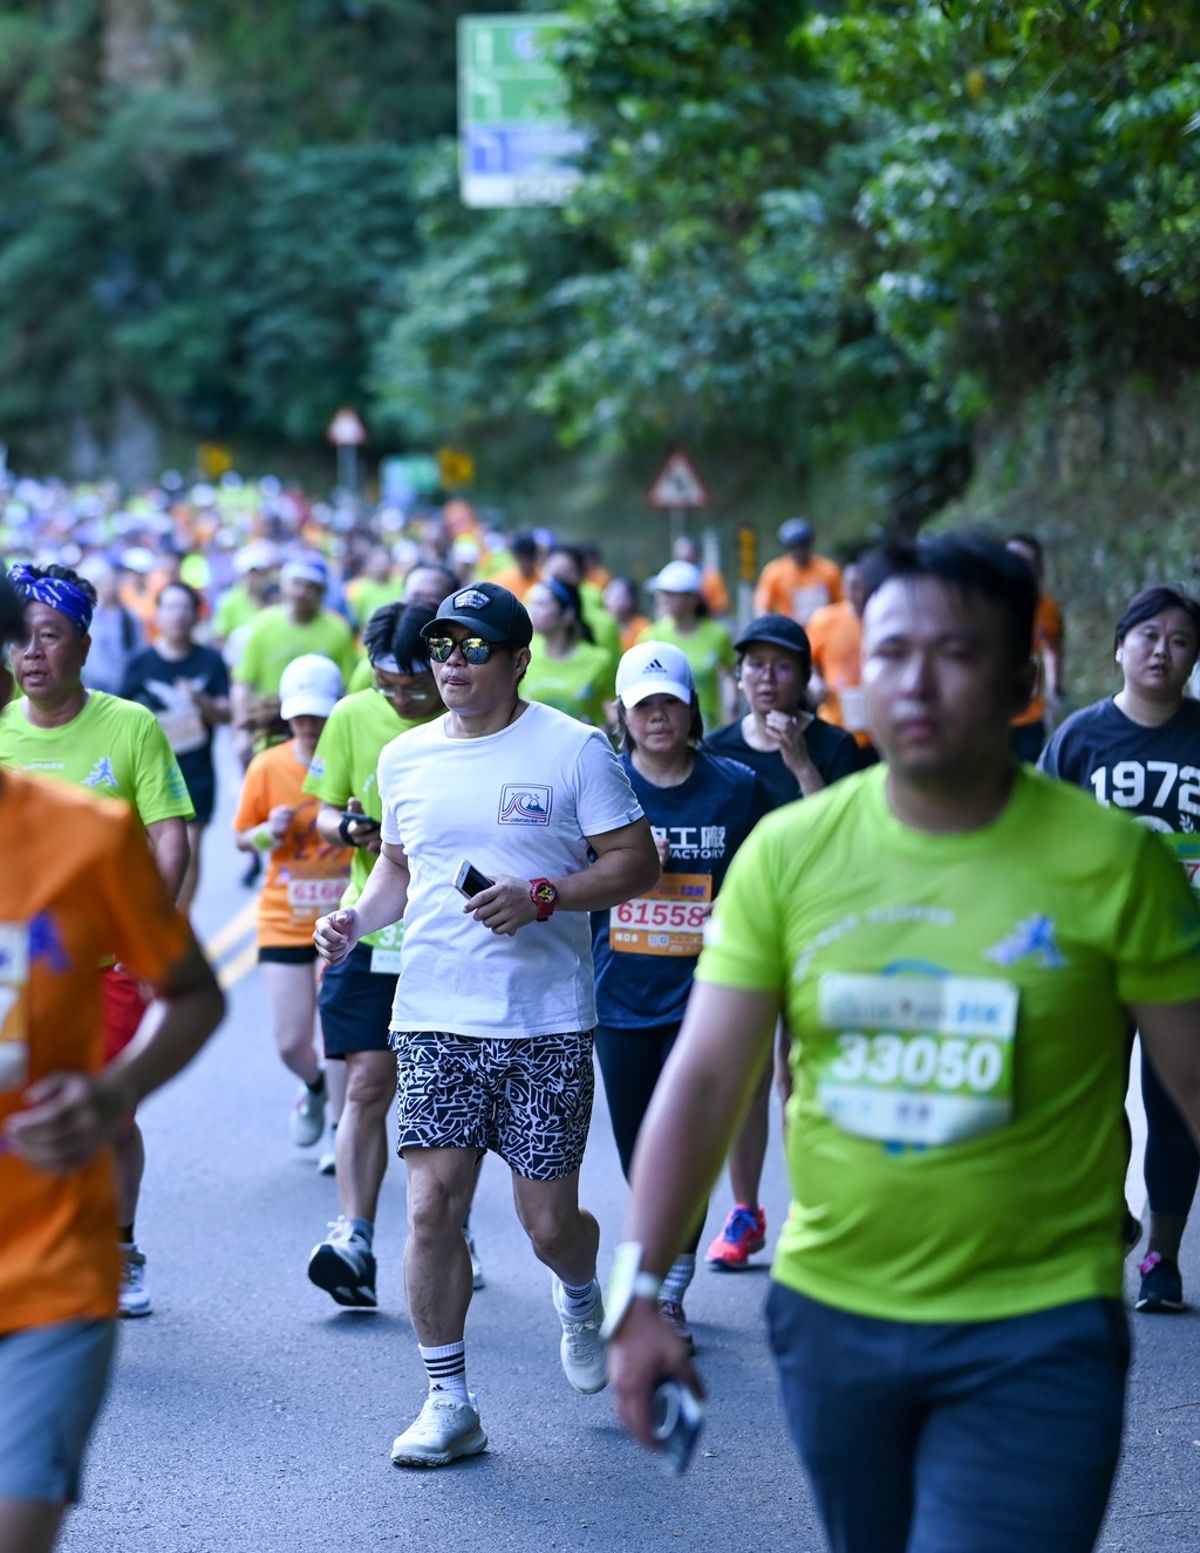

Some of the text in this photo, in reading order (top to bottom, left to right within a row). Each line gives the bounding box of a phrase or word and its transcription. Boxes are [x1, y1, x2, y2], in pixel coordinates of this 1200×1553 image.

[1091, 761, 1200, 816] 1972
[669, 849, 724, 859] ACTORY
[617, 902, 704, 927] 61558
[832, 1034, 1003, 1091] 33050
